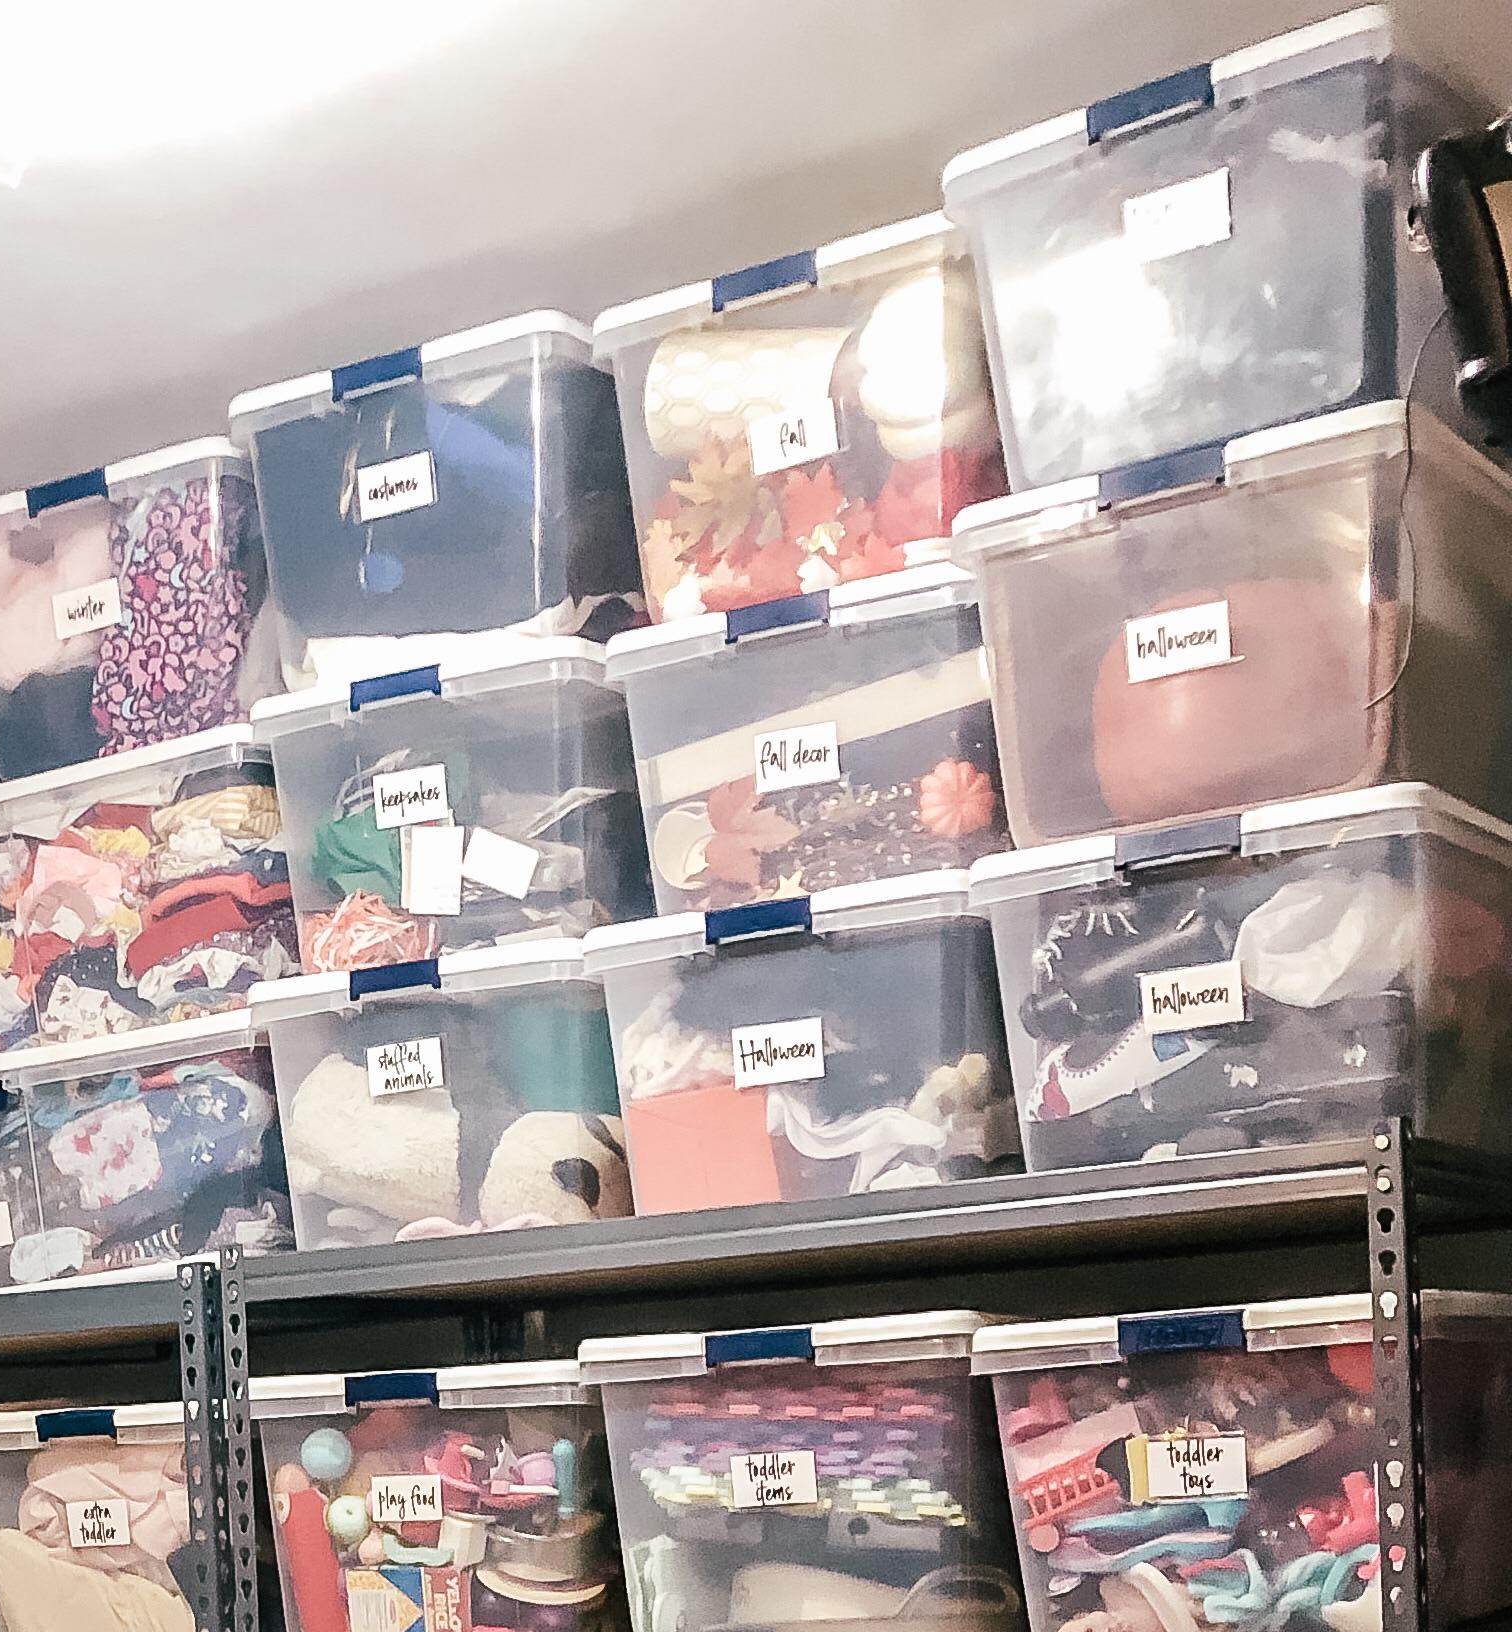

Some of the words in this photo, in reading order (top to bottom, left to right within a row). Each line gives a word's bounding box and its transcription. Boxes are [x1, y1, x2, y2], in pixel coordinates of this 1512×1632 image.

[779, 418, 806, 457] fall
[368, 475, 419, 502] costumes
[67, 595, 106, 621] winter
[1136, 625, 1218, 659] halloween
[759, 740, 787, 780] fall
[792, 739, 830, 769] decor
[379, 780, 441, 818] keepsakes
[1151, 982, 1230, 1015] halloween
[378, 1042, 421, 1075] stuffed
[739, 1037, 816, 1073] Halloween
[384, 1063, 434, 1091] animals
[745, 1454, 796, 1482] toddler
[1166, 1440, 1223, 1468] toddler
[755, 1480, 794, 1507] items
[1179, 1462, 1214, 1495] toys
[83, 1501, 112, 1523] extra
[378, 1486, 406, 1520] play
[411, 1484, 436, 1515] food
[79, 1521, 117, 1544] toddler
